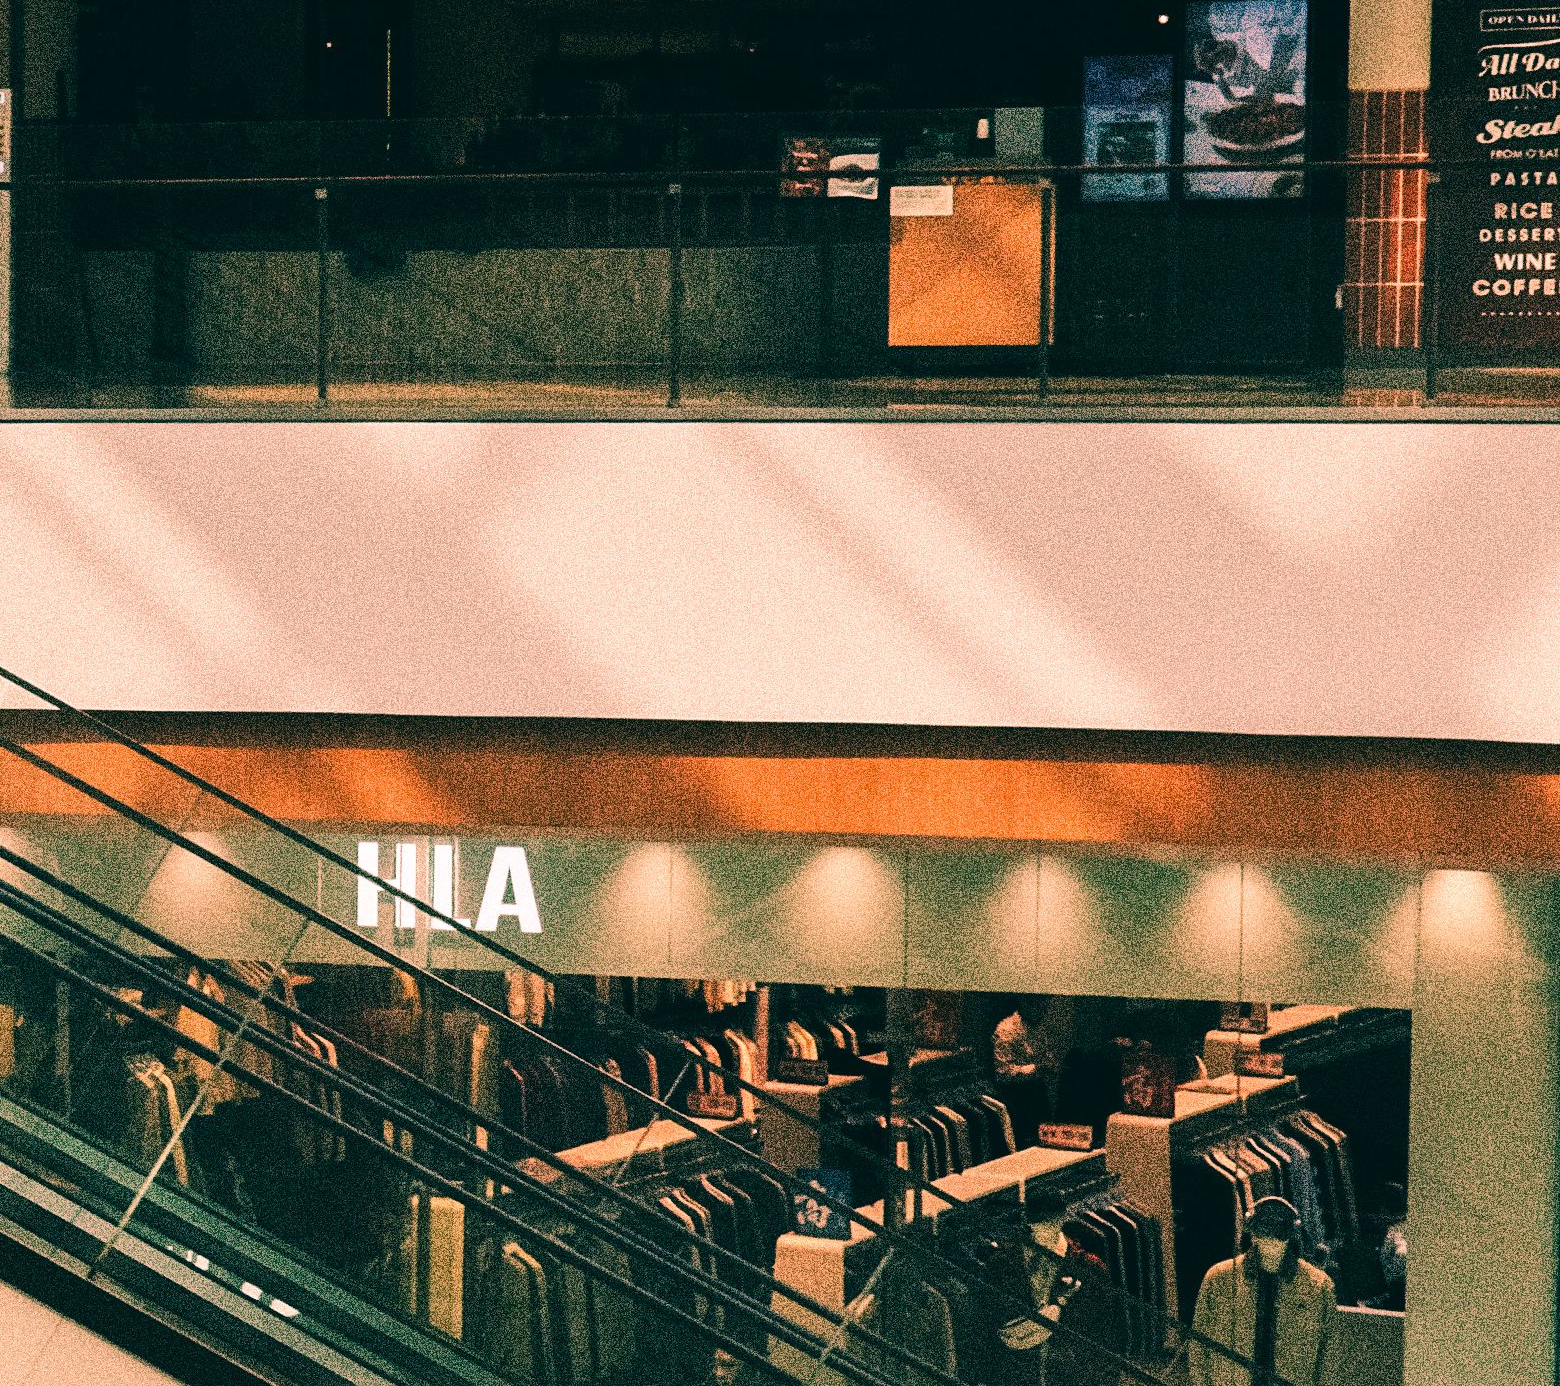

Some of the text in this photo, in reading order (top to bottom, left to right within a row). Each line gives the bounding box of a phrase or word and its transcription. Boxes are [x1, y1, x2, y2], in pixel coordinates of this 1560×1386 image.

[1477, 51, 1519, 78] All
[1489, 171, 1559, 187] PASTA
[1493, 201, 1554, 220] RICE
[1478, 227, 1560, 243] DESSER
[1493, 252, 1556, 271] WINE
[356, 841, 543, 934] HLA
